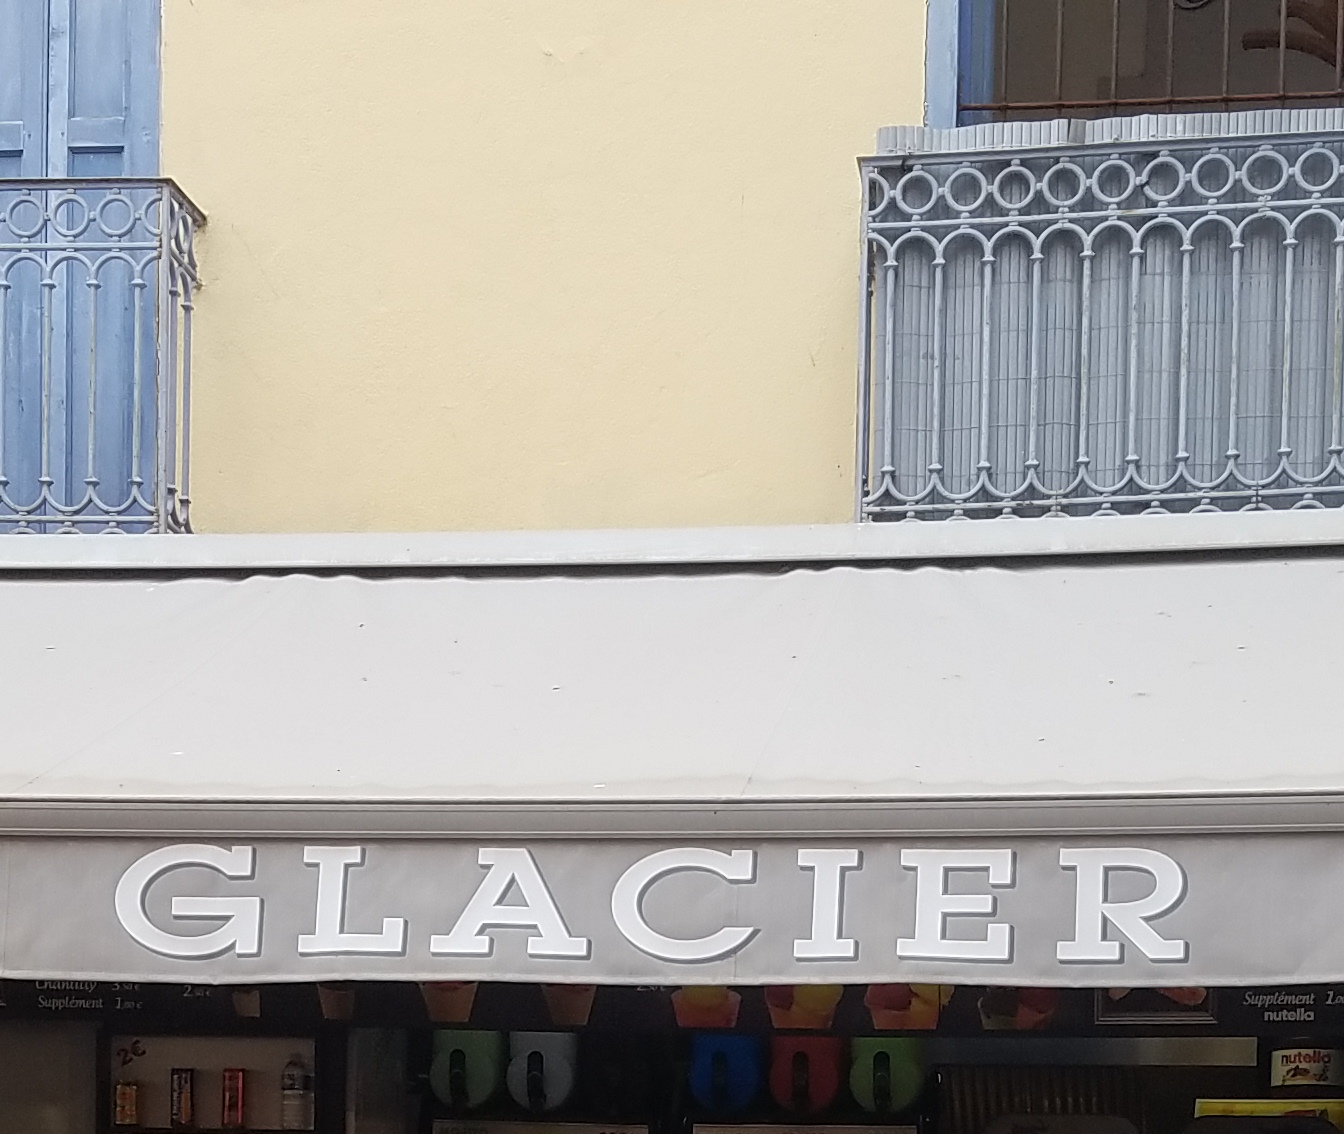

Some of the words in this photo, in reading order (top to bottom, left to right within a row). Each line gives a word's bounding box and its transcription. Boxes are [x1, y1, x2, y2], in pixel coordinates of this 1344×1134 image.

[113, 841, 1190, 965] GLACIER
[35, 980, 99, 993] Chantilly
[37, 994, 104, 1011] Supplément
[1242, 991, 1315, 1008] Supplément
[1263, 1008, 1315, 1021] nutella
[1281, 1050, 1331, 1065] nutella
